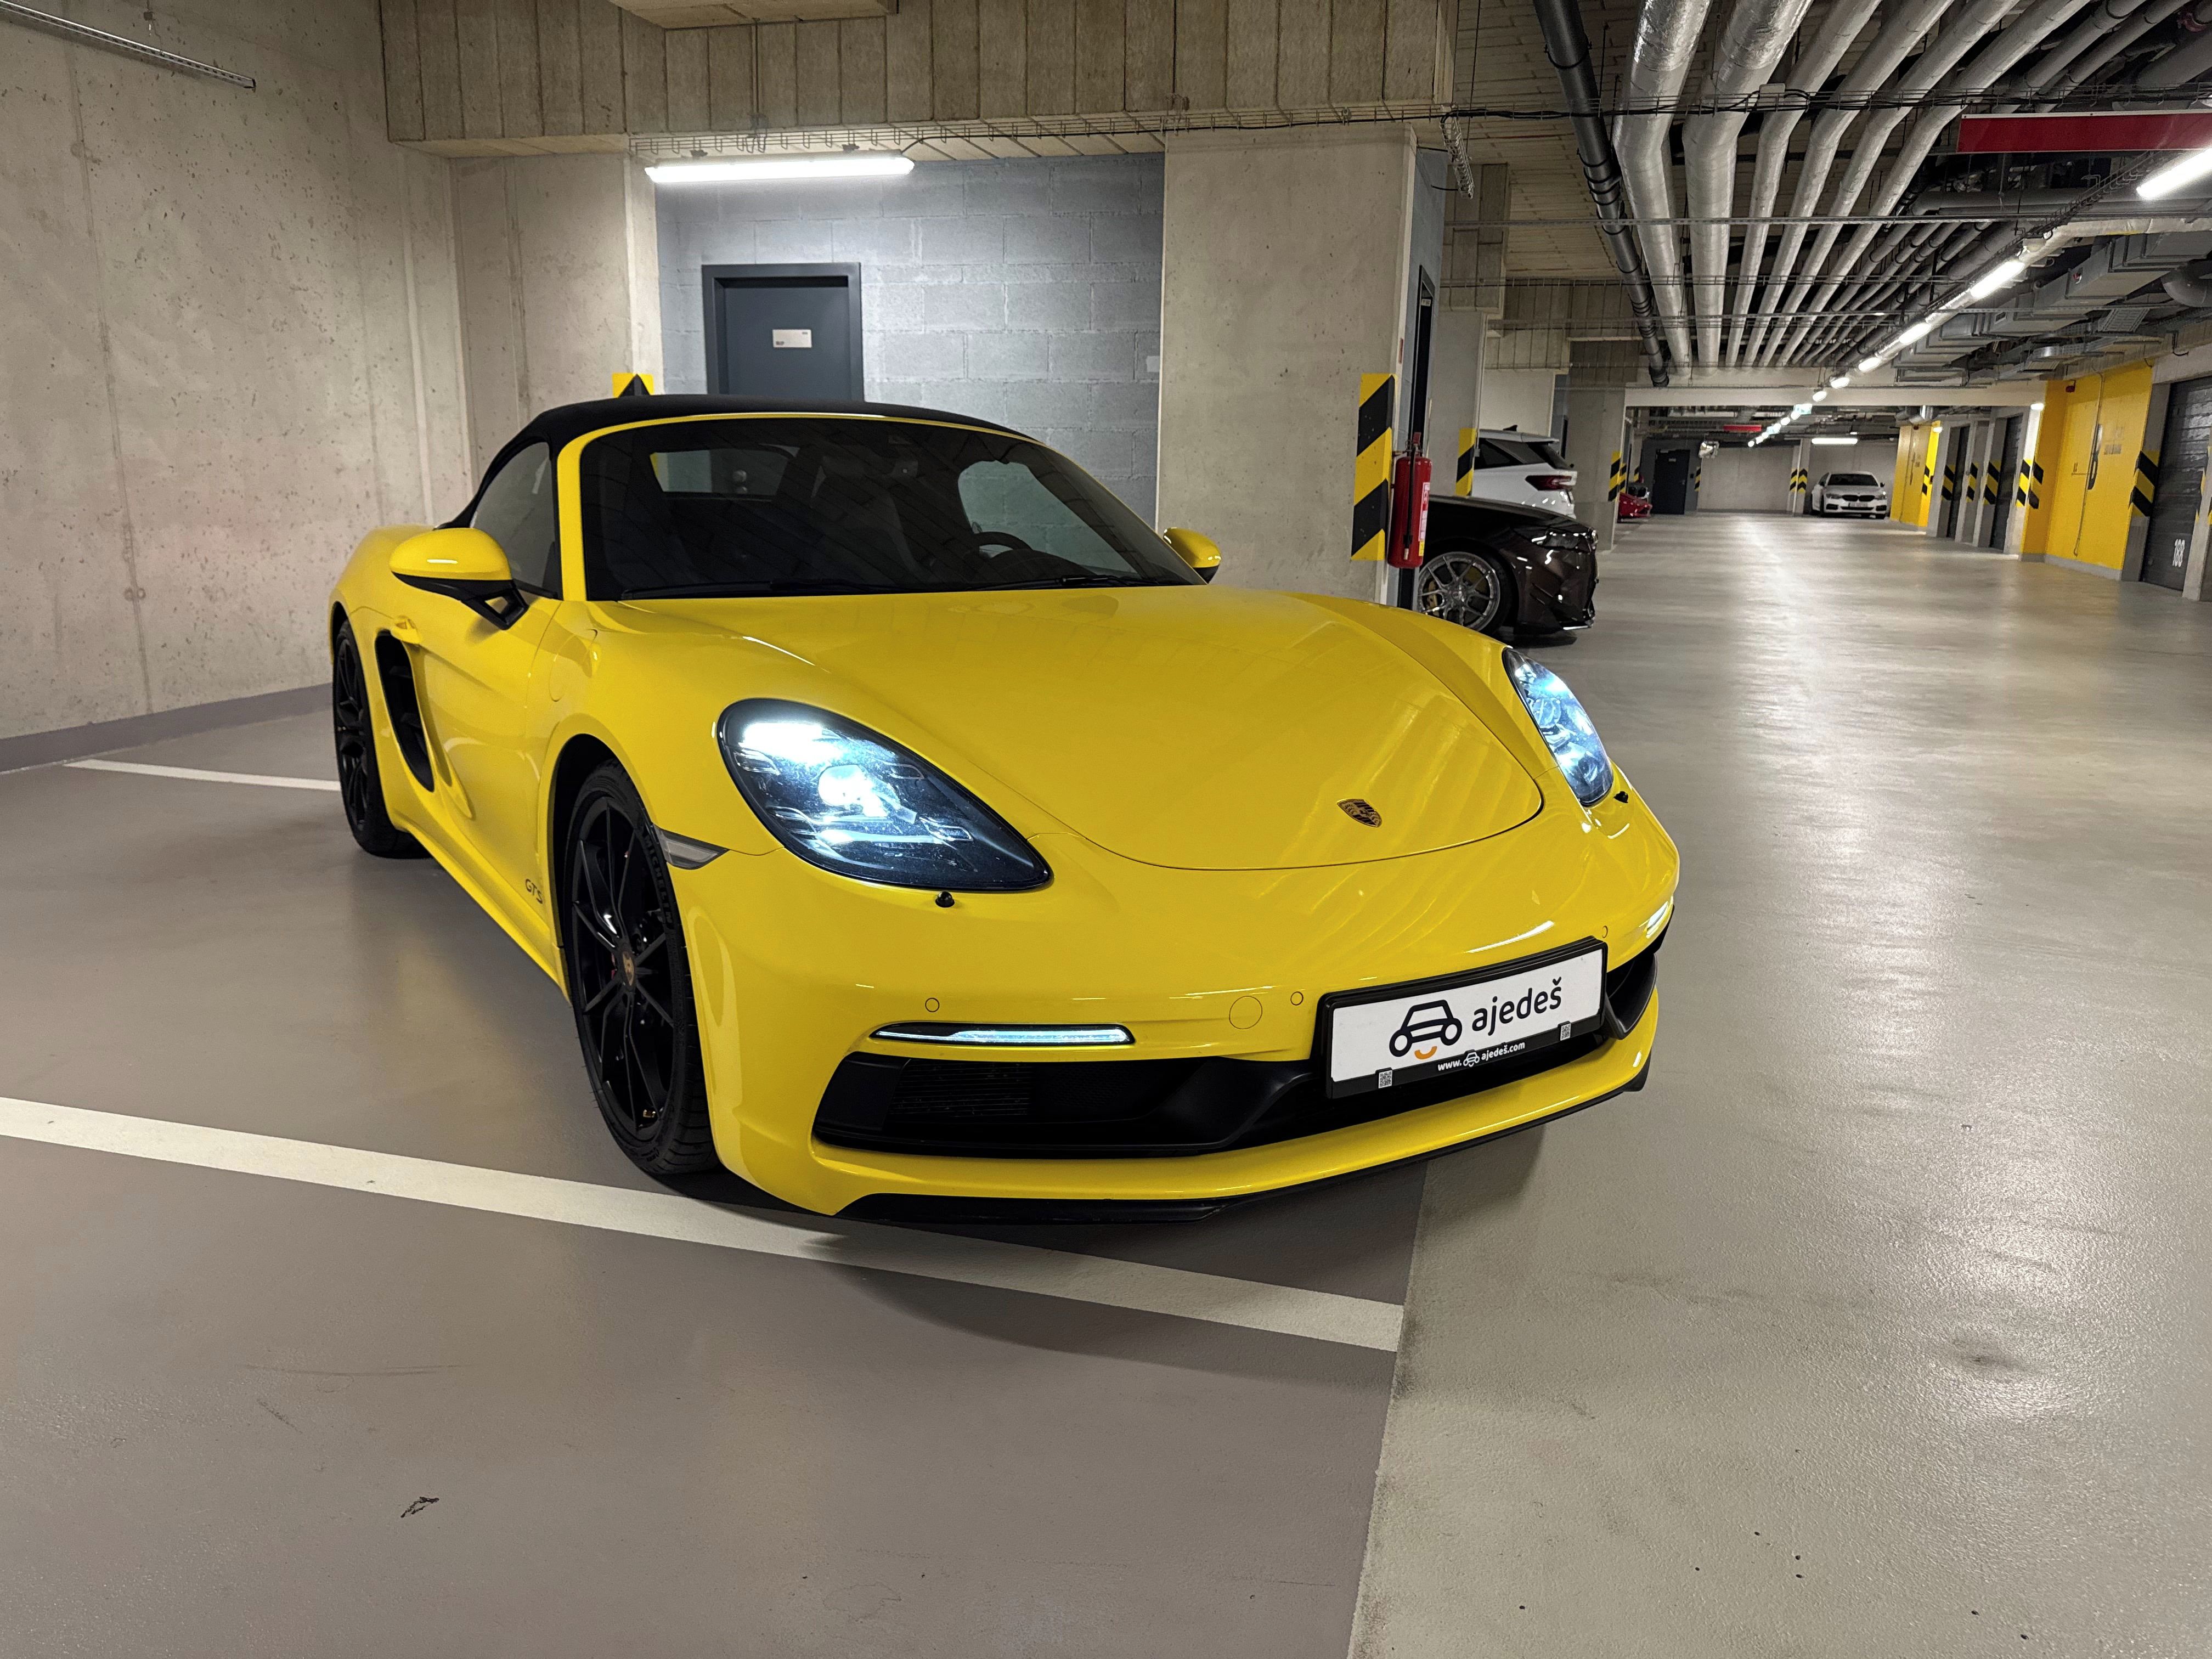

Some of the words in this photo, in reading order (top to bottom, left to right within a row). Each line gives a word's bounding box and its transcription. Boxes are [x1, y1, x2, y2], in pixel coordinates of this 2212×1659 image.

[2172, 539, 2185, 567] 188
[526, 878, 543, 904] GTS
[644, 834, 673, 924] MICHELIN
[1472, 977, 1562, 1036] ajedeš
